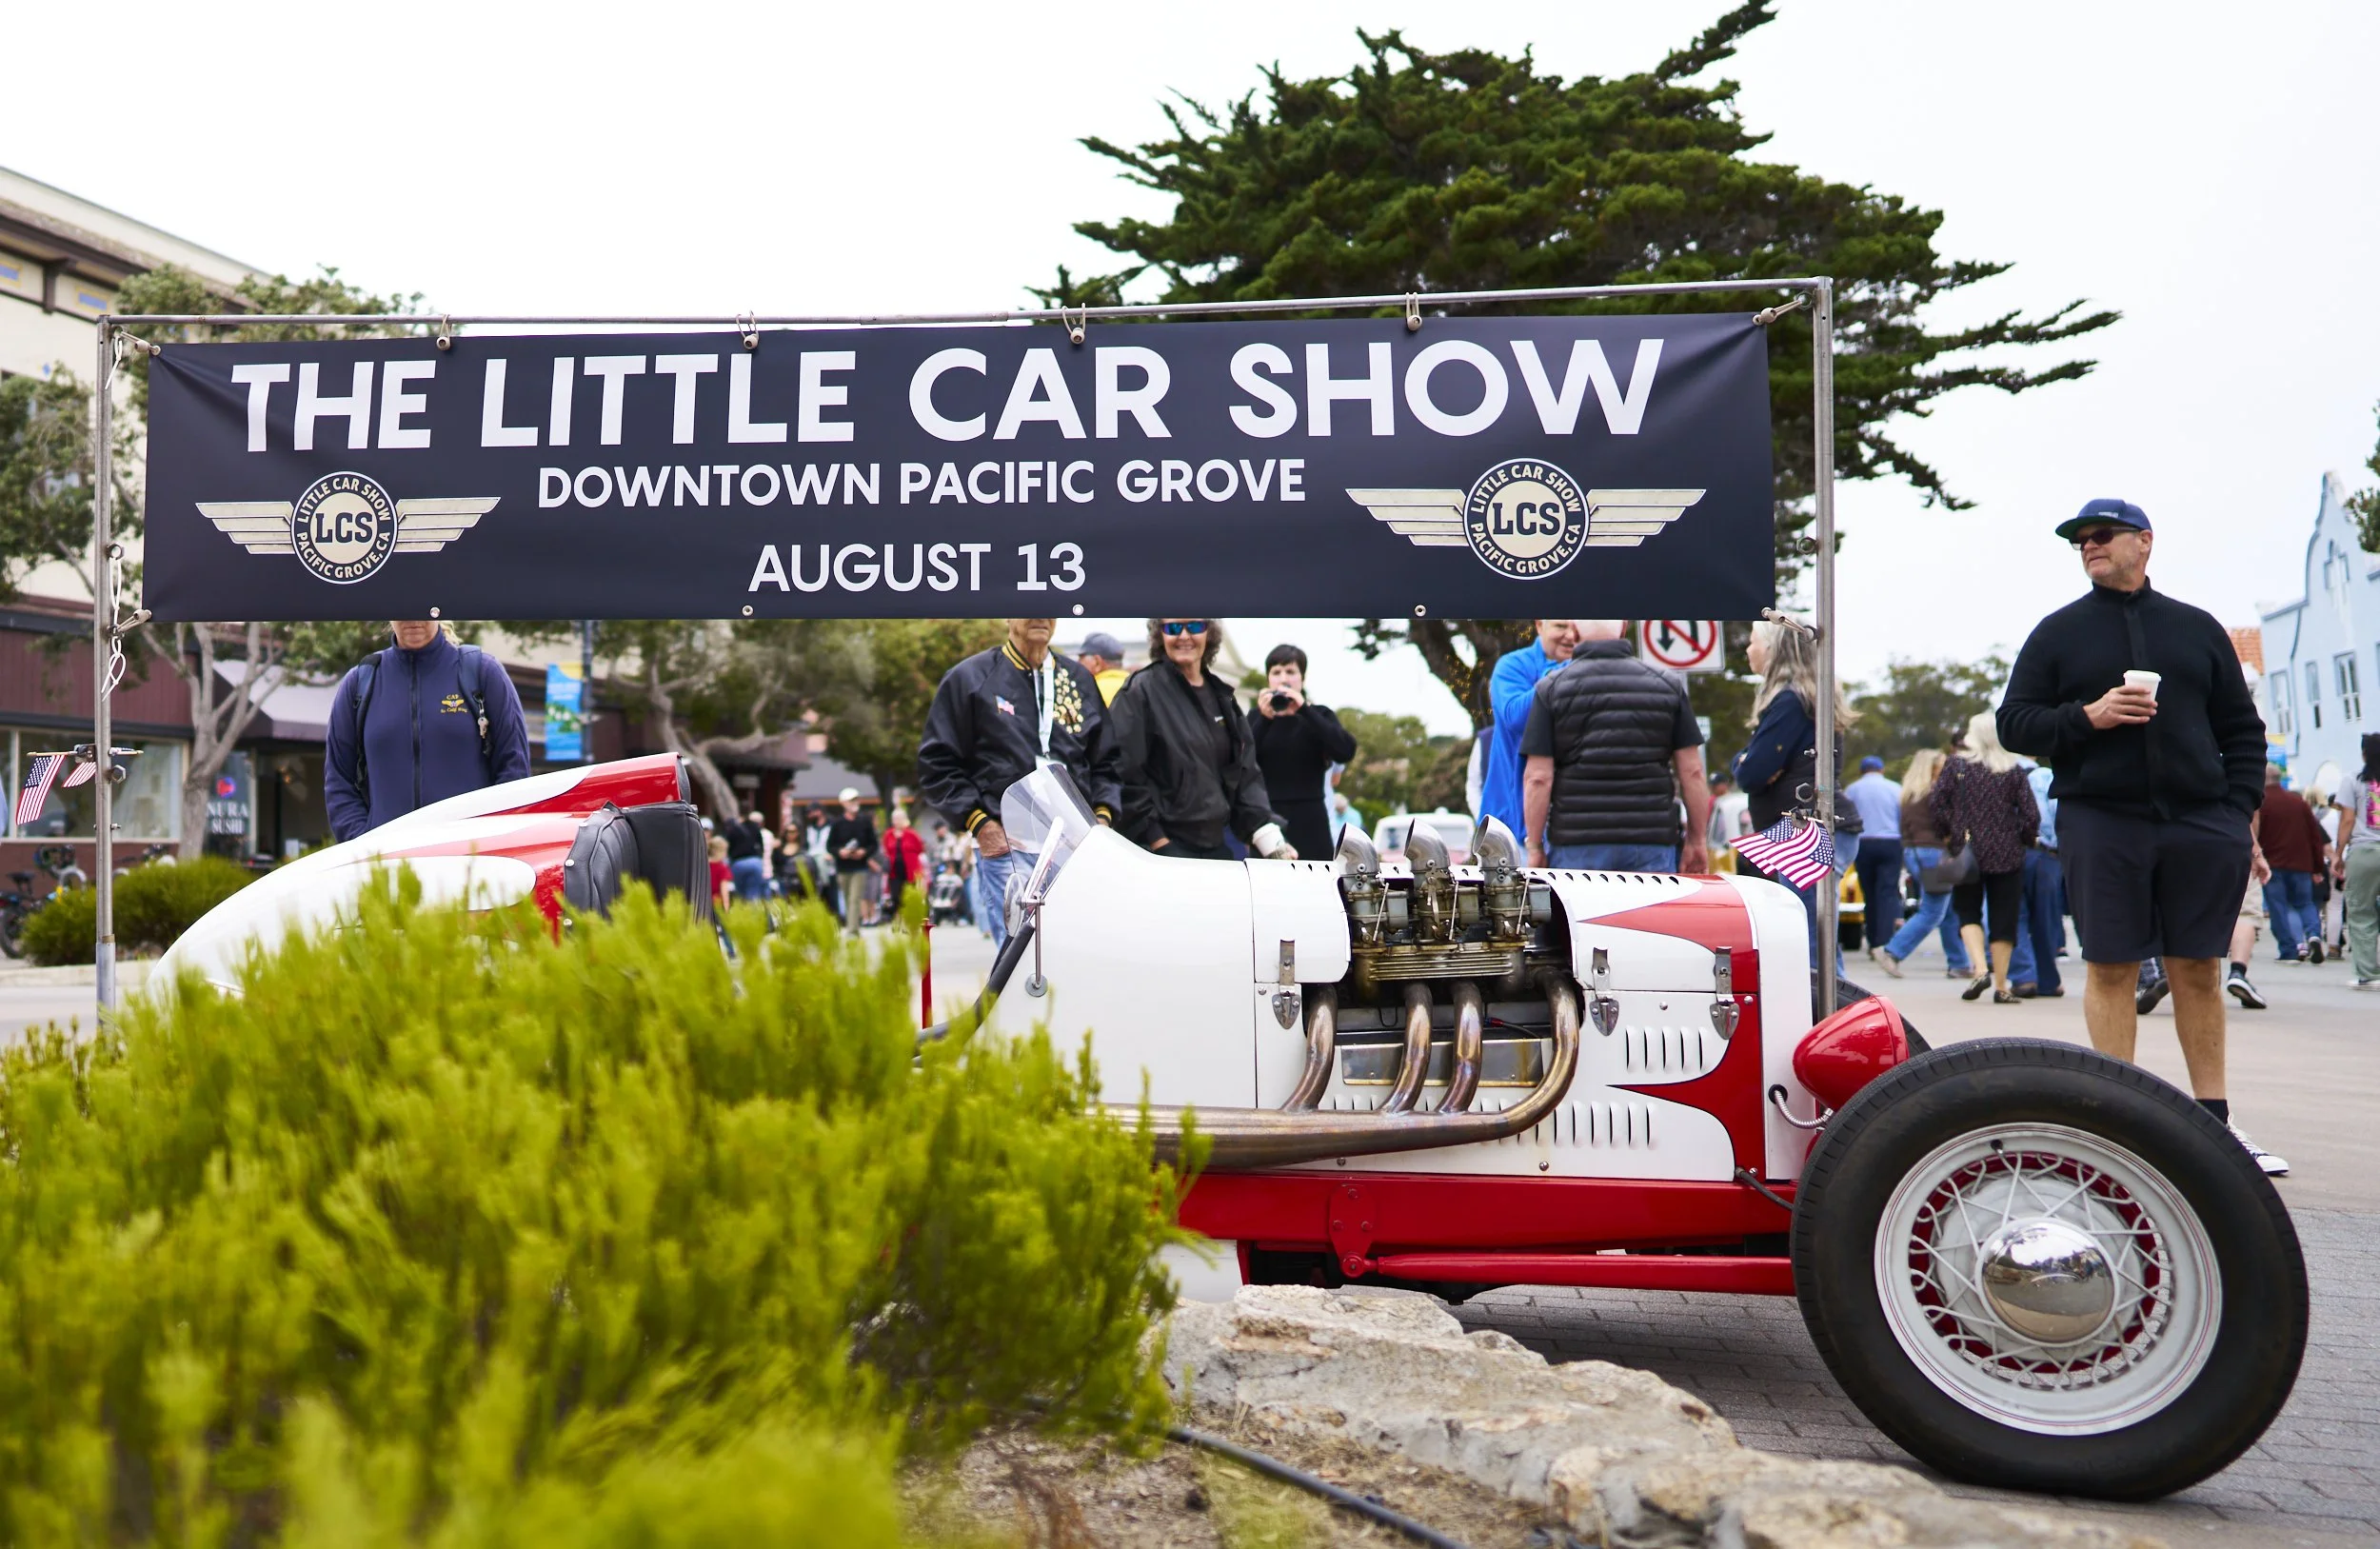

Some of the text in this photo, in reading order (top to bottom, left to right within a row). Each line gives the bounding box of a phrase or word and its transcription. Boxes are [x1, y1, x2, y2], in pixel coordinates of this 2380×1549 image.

[230, 338, 1665, 452] THE LITTLE CAR SHOW
[297, 477, 391, 524] LITTLE CAR SHOW
[538, 458, 1306, 508] DOWNTOWN PACIFIC GROVE
[1470, 464, 1582, 514] LITTLE CAR SHOW
[315, 511, 373, 544] LCS
[1492, 502, 1561, 536] LCS
[297, 531, 391, 579] PACIFIC GROVE, CA
[747, 542, 1086, 592] AUGUST 13
[1470, 522, 1581, 574] PACIFIC GROVE, CA
[212, 819, 244, 835] SUSHI
